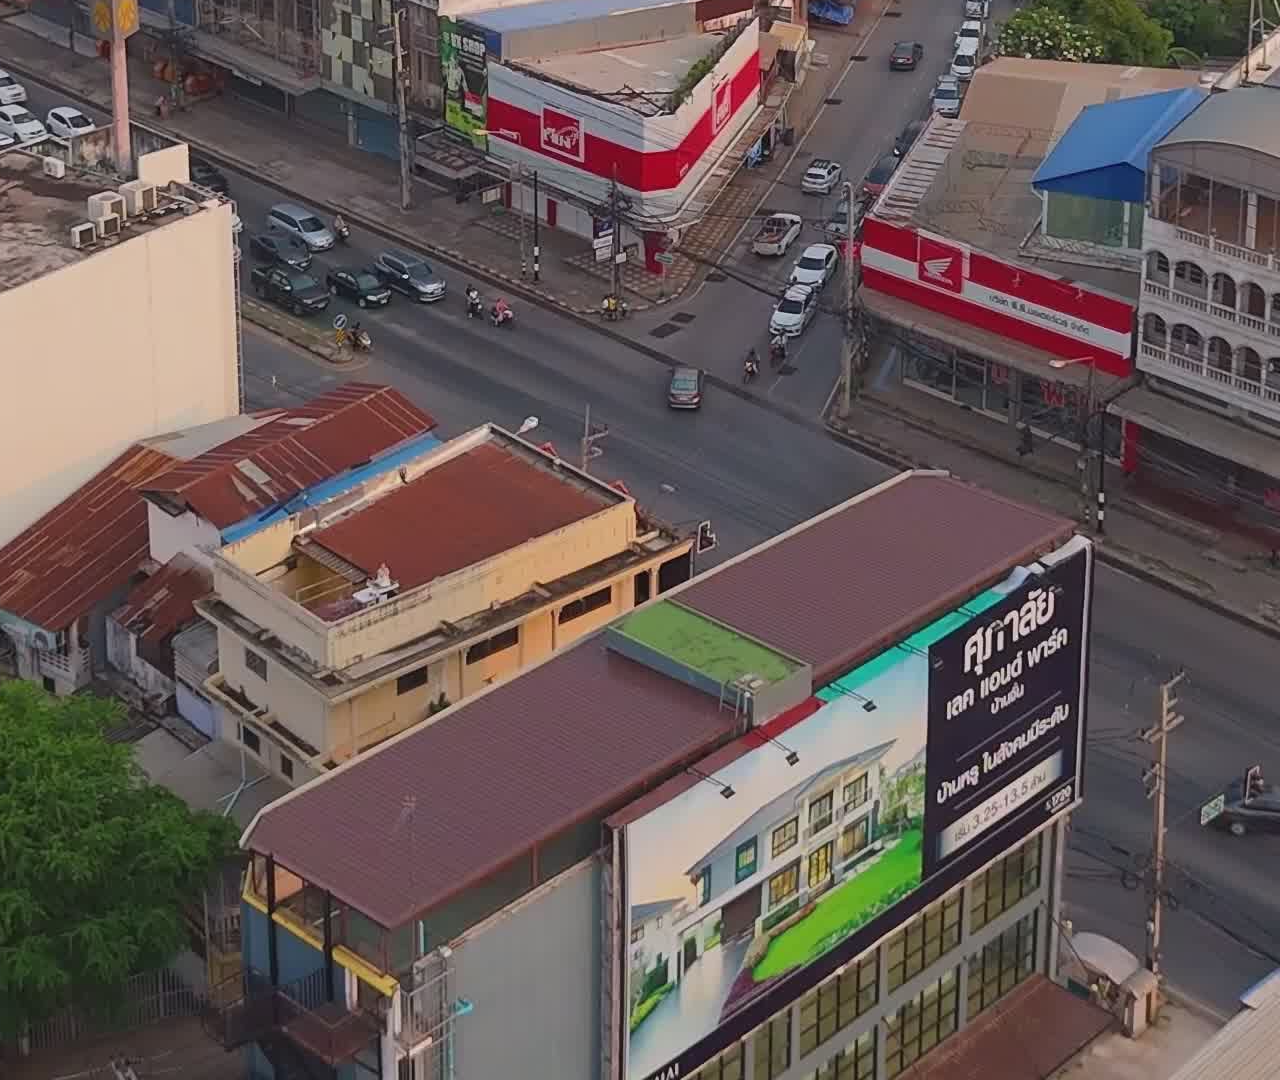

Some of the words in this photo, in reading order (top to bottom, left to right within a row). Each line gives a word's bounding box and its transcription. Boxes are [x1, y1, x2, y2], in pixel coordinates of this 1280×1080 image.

[946, 687, 975, 720] เลค
[980, 650, 1024, 700] แอนด์
[1027, 626, 1069, 669] พาร์ค
[963, 585, 1057, 676] ศุภาลัย
[936, 754, 980, 805] บ้านหรู
[982, 702, 1070, 773] ในสังคมมีระดับ
